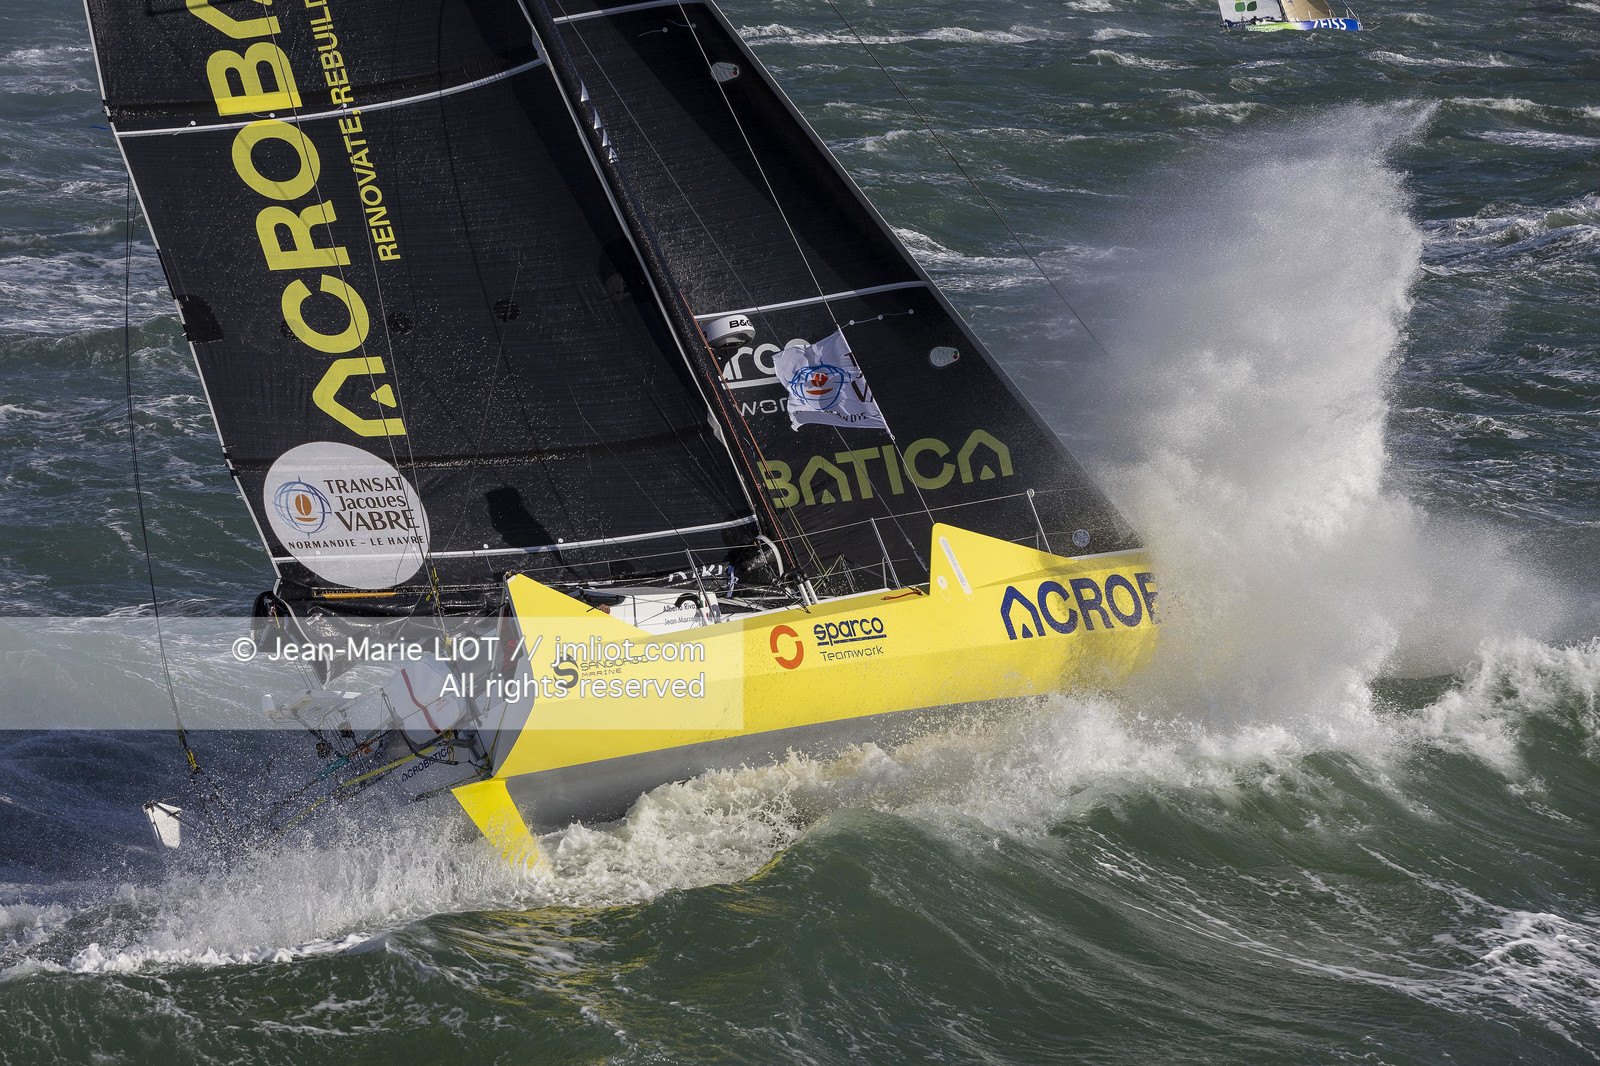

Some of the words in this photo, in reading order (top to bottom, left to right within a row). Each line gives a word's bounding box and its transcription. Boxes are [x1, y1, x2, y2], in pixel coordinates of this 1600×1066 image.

[338, 109, 401, 261] RENOVATE,
[323, 476, 404, 494] TRANSAT
[336, 495, 407, 512] Jacques
[335, 508, 421, 532] VABRE
[288, 539, 356, 550] NORMANDIE
[371, 537, 383, 547] LE
[387, 534, 426, 545] HAVRE
[813, 616, 884, 646] sparco
[819, 644, 884, 662] Teamwork
[579, 654, 649, 671] SANGIORGO
[581, 667, 622, 678] MARINE
[401, 745, 454, 782] ACROBTICA
